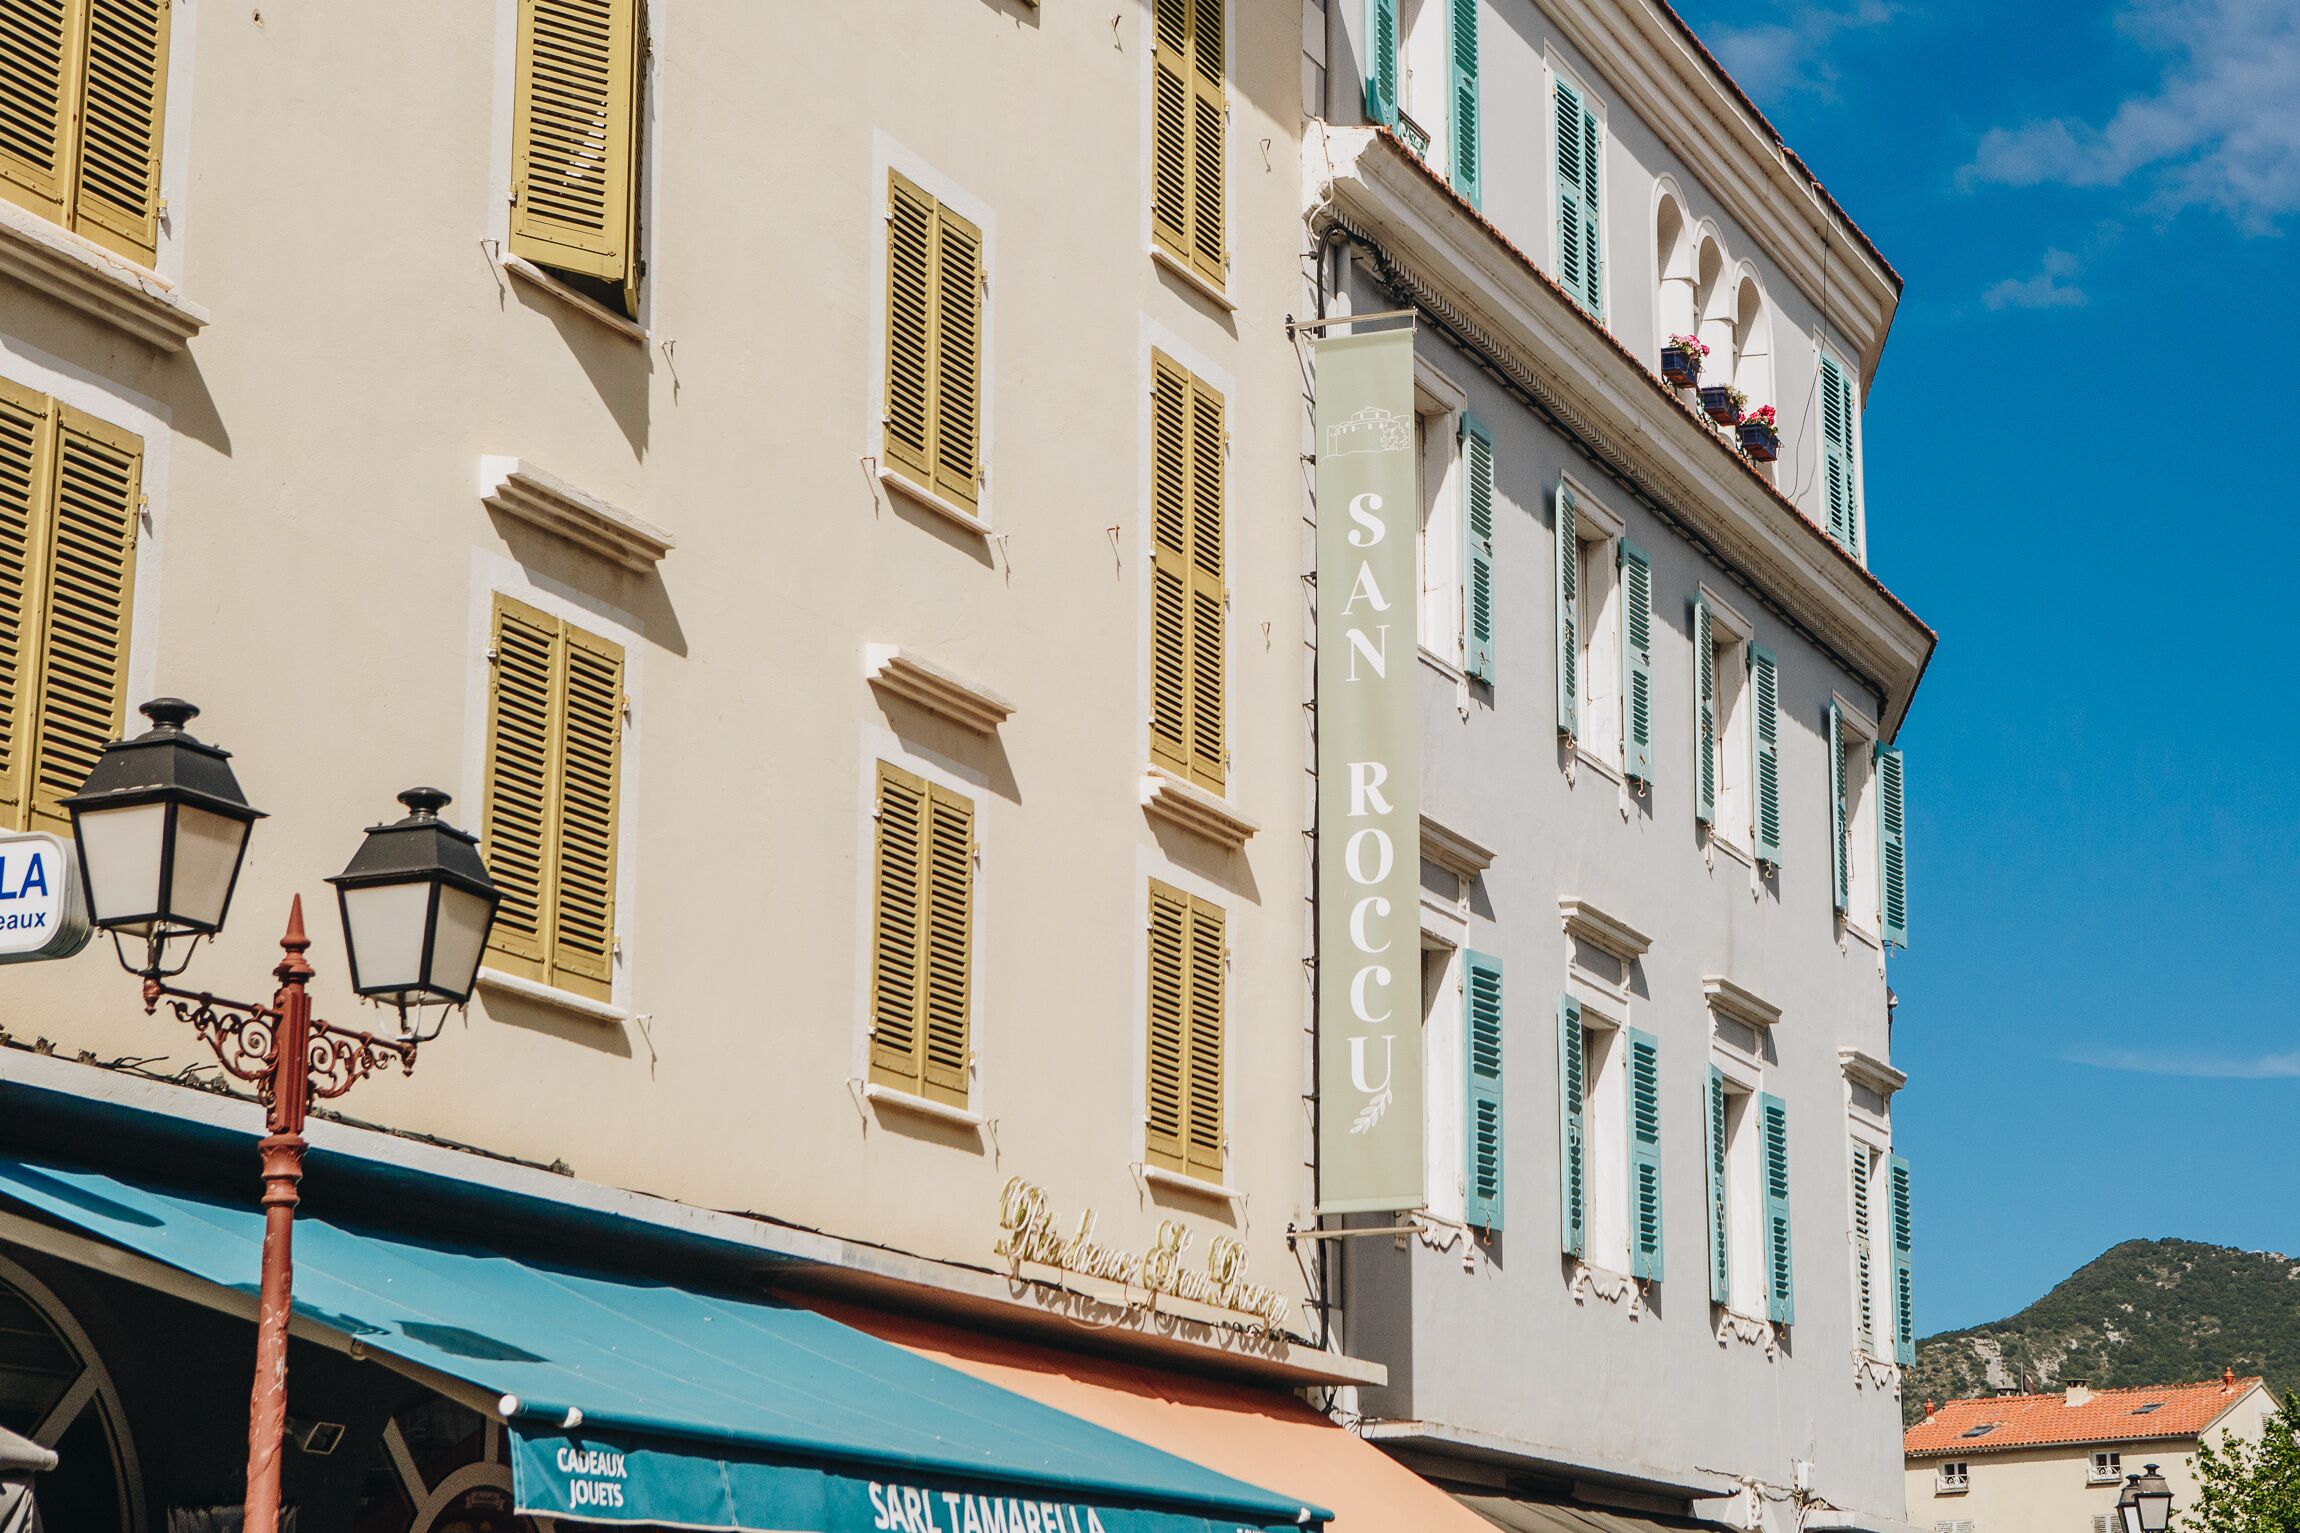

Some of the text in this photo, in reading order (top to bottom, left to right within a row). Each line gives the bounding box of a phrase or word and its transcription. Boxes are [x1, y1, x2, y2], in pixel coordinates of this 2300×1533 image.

[1341, 493, 1396, 1093] SAN ROCCU
[1142, 1219, 1211, 1299] San
[557, 1447, 628, 1479] CADEAUX
[570, 1479, 624, 1509] JOUETS
[868, 1481, 942, 1533] SARL
